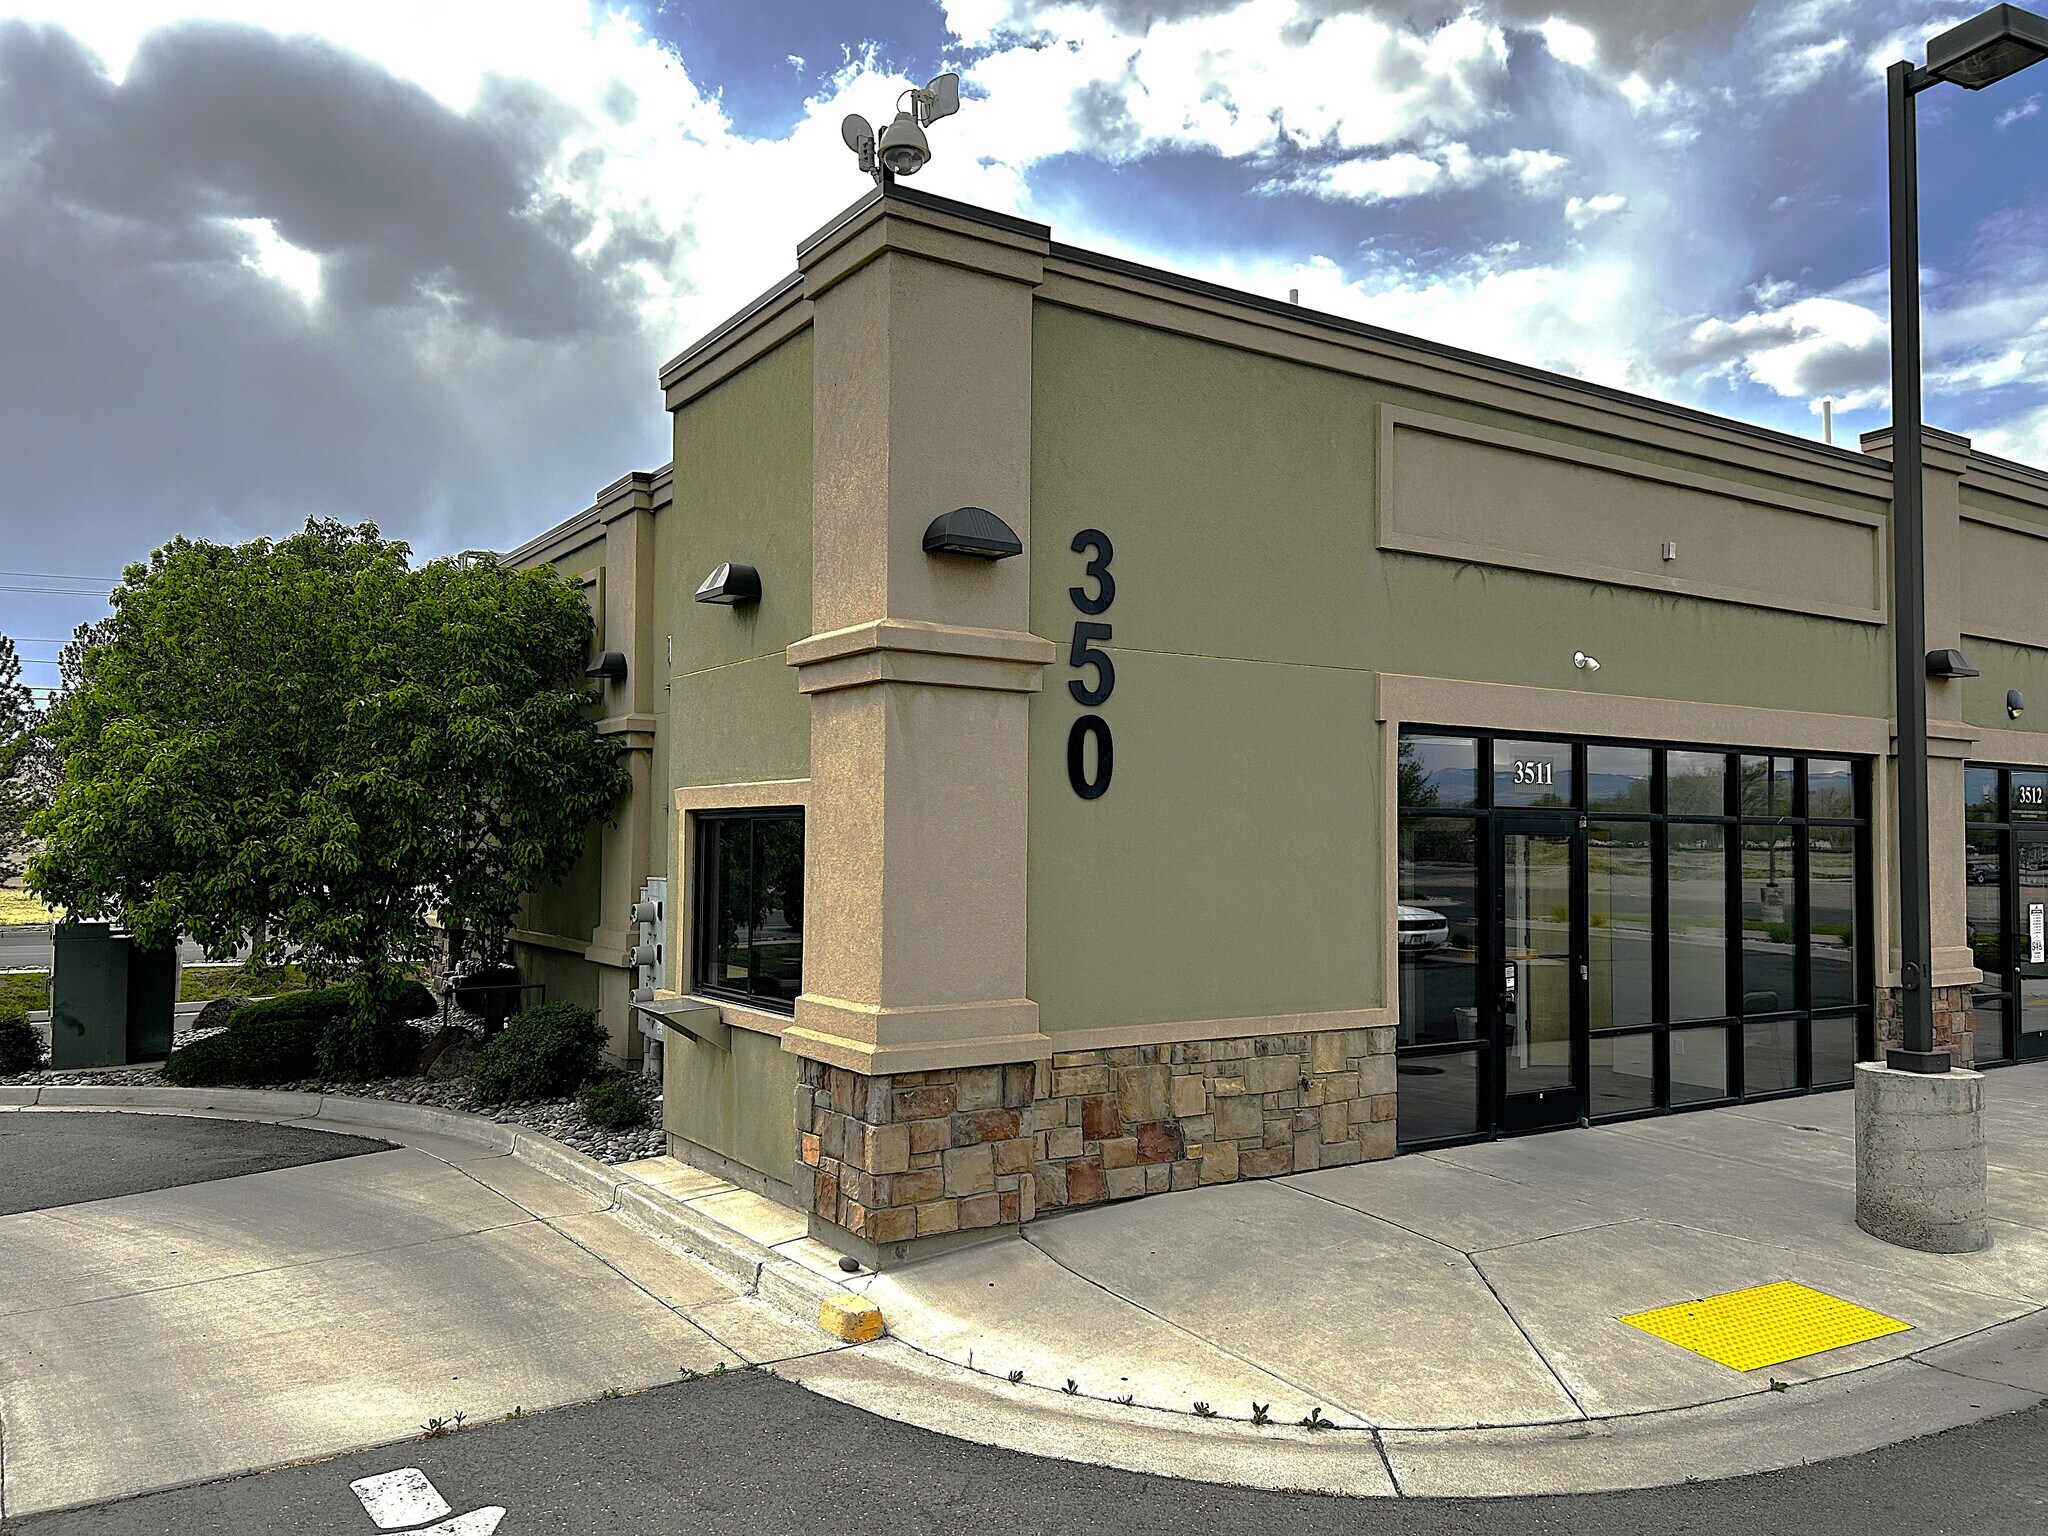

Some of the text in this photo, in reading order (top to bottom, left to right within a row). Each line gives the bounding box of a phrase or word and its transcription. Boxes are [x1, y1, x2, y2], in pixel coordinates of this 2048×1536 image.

[1067, 528, 1116, 800] 350
[1513, 760, 1553, 785] 3511
[2019, 786, 2043, 804] 3512
